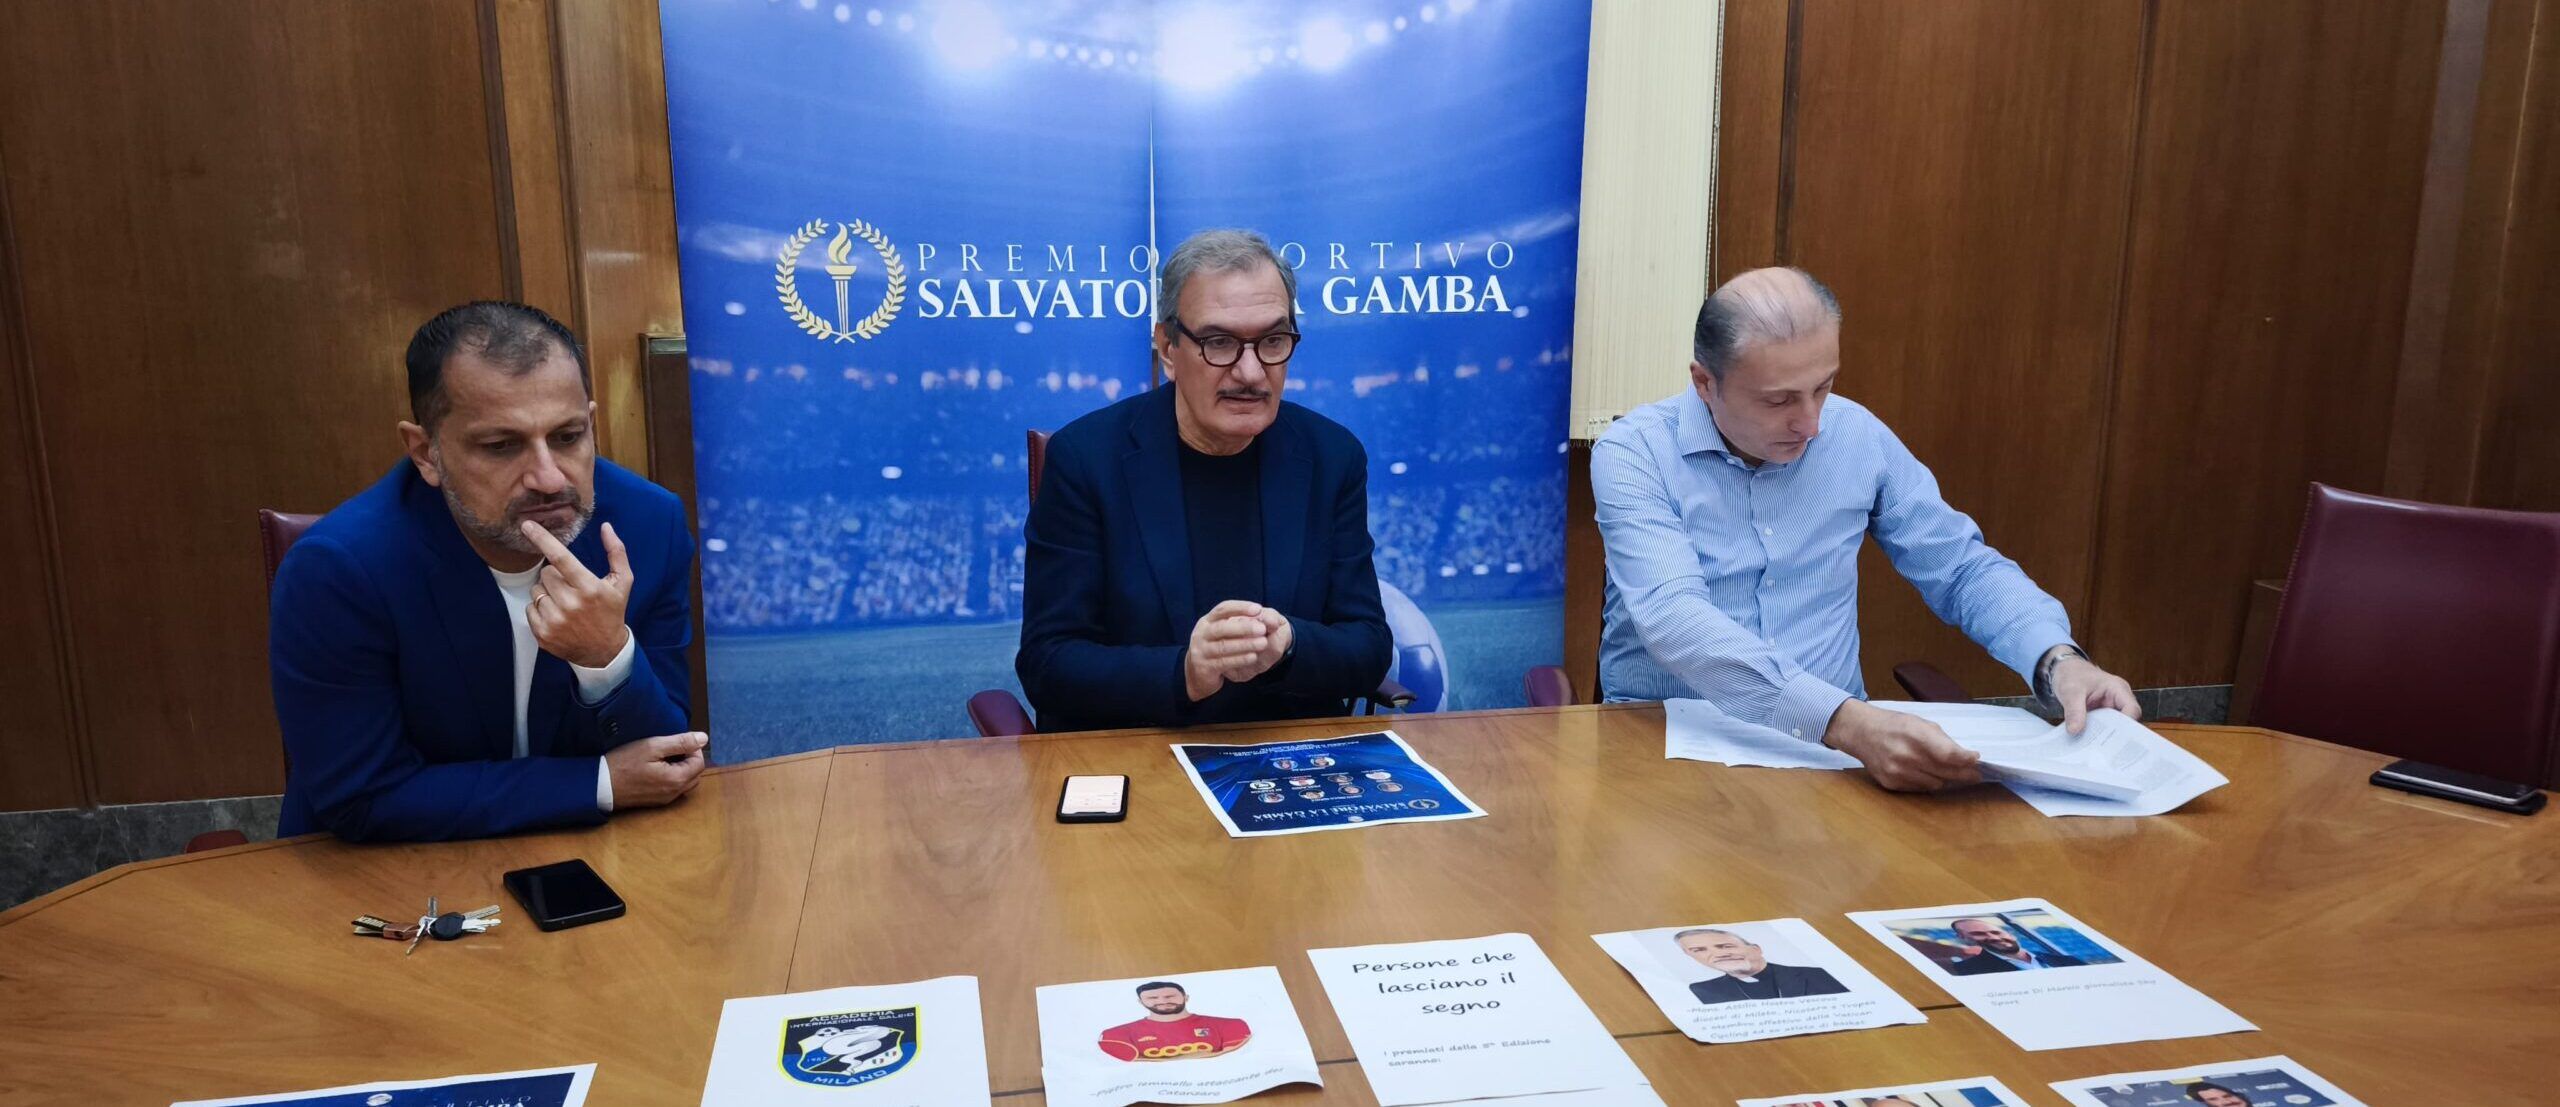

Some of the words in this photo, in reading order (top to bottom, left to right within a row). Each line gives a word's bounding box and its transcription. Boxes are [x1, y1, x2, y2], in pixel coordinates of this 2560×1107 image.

[918, 243, 1160, 273] PREMIO
[1279, 241, 1516, 271] ORTIVO
[917, 276, 1163, 319] SALVATO
[1322, 274, 1514, 316] GAMBA
[1352, 956, 1460, 975] Persone
[1471, 949, 1517, 966] che
[1378, 976, 1488, 994] lasciano
[1501, 971, 1516, 985] il
[1422, 999, 1501, 1015] segno
[789, 1016, 874, 1029] INTERNAZIONALE
[878, 1012, 915, 1020] CALCIO
[809, 1010, 895, 1023] ACCADEMIA
[1391, 1045, 1444, 1058] premiati
[1449, 1043, 1480, 1052] della
[1501, 1038, 1551, 1048] Edizione
[812, 1069, 888, 1085] MILANO
[1157, 1088, 1222, 1097] Catanzaro
